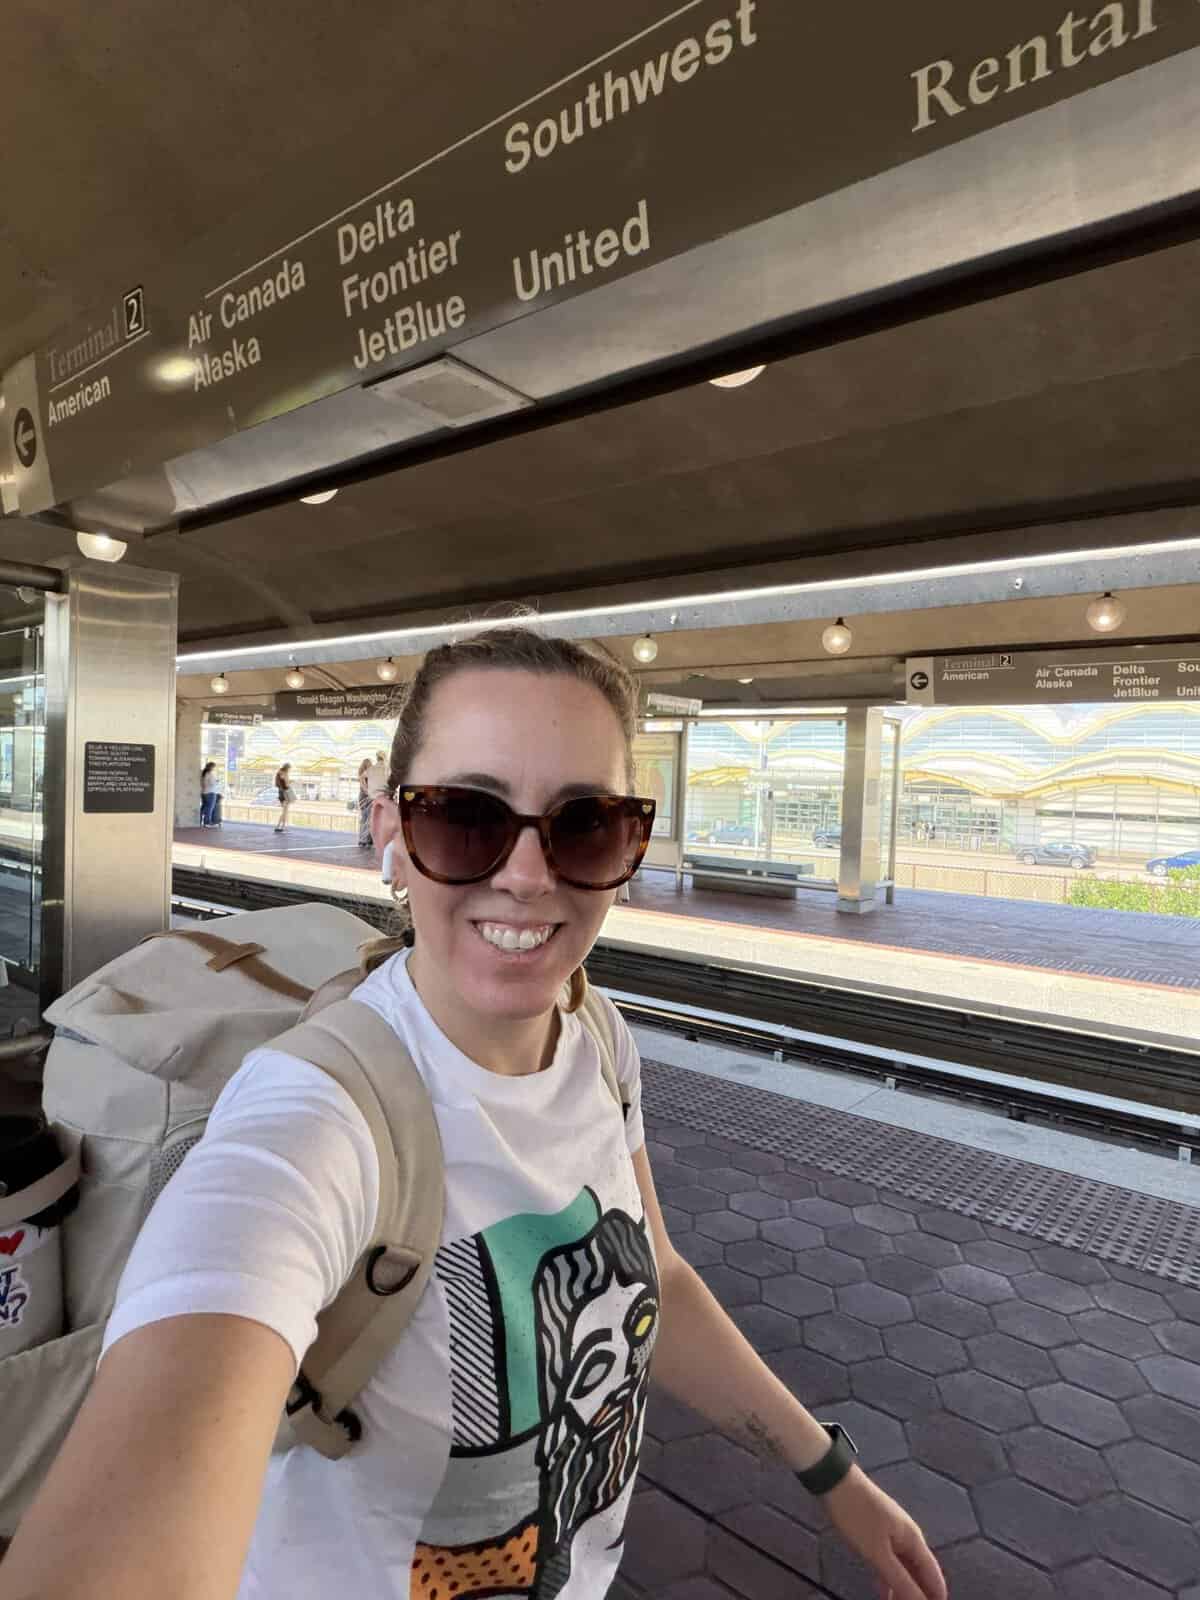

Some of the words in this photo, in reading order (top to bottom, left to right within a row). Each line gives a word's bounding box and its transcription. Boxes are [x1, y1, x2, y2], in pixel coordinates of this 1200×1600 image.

[503, 0, 757, 173] Southwest
[911, 0, 1157, 132] Rental
[337, 197, 415, 265] Delta
[512, 200, 650, 302] United
[342, 229, 462, 318] Frontier
[187, 309, 212, 350] Air
[219, 260, 305, 330] Canada
[353, 295, 466, 370] JetBlue
[48, 306, 121, 381] Terminal
[193, 337, 262, 391] Alaska
[48, 375, 111, 426] American
[942, 671, 990, 681] American
[1035, 668, 1050, 678] Air
[1055, 667, 1098, 677] Canada
[1035, 679, 1073, 689] Alaska
[1113, 665, 1145, 675] Delta
[1113, 676, 1160, 687] Frontier
[1113, 687, 1159, 698] JetBlue
